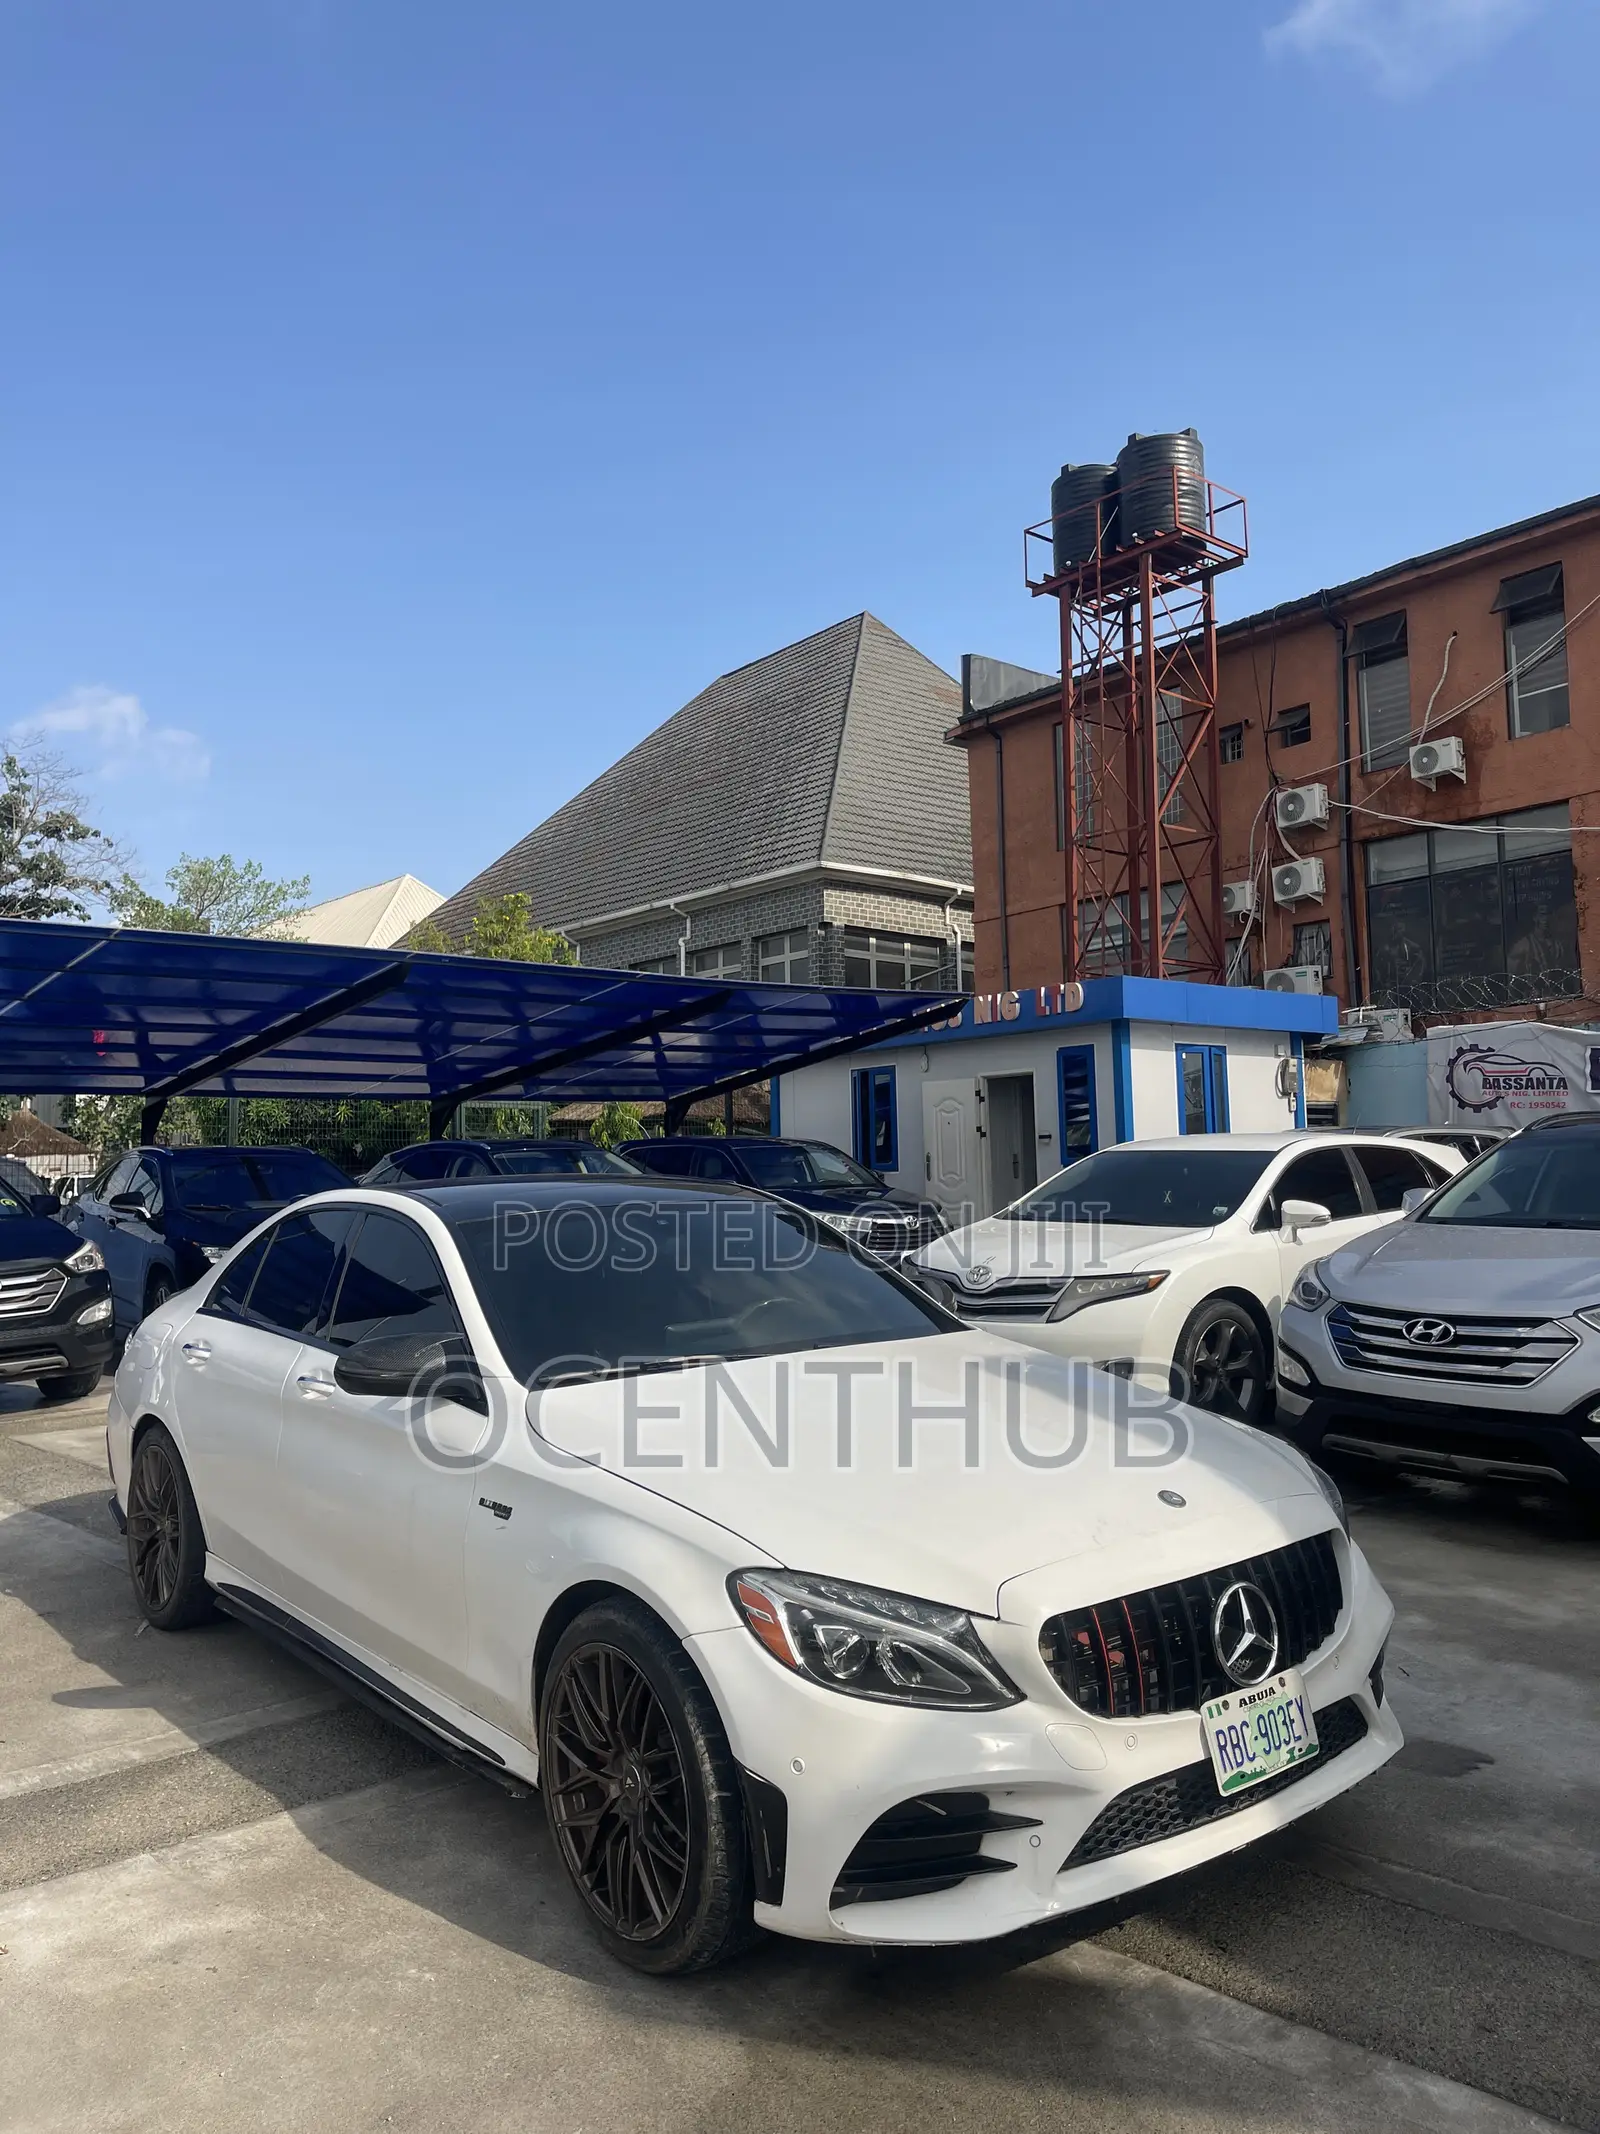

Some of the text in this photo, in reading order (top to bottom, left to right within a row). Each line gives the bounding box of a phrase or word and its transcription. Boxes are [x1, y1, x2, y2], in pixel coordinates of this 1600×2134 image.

[973, 991, 1020, 1025] NIG
[1036, 982, 1084, 1017] LTD
[1482, 1077, 1568, 1090] BASSANTA
[1238, 1686, 1276, 1708] ABUJA
